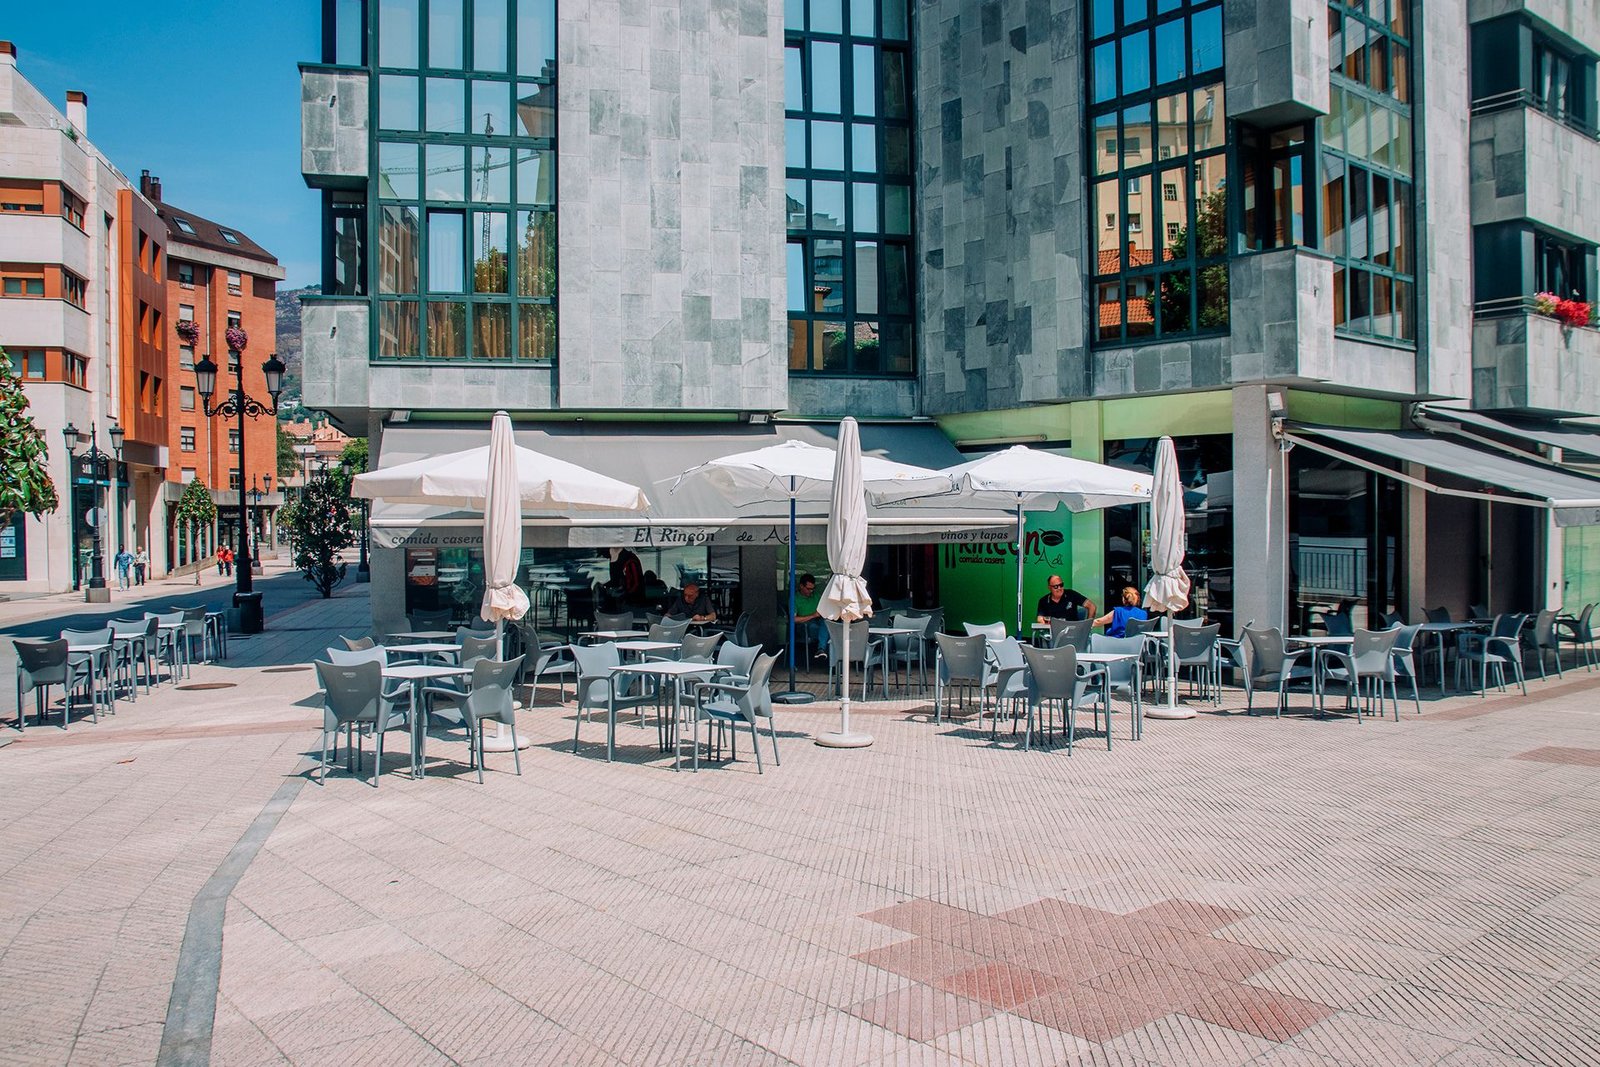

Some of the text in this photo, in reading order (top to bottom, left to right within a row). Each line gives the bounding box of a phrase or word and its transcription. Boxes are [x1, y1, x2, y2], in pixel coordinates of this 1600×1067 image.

[391, 533, 483, 544] comida casera
[633, 528, 650, 542] El
[660, 528, 715, 542] Rincón
[736, 531, 754, 542] de
[941, 530, 1009, 541] vinos y tapas
[959, 555, 982, 564] comida
